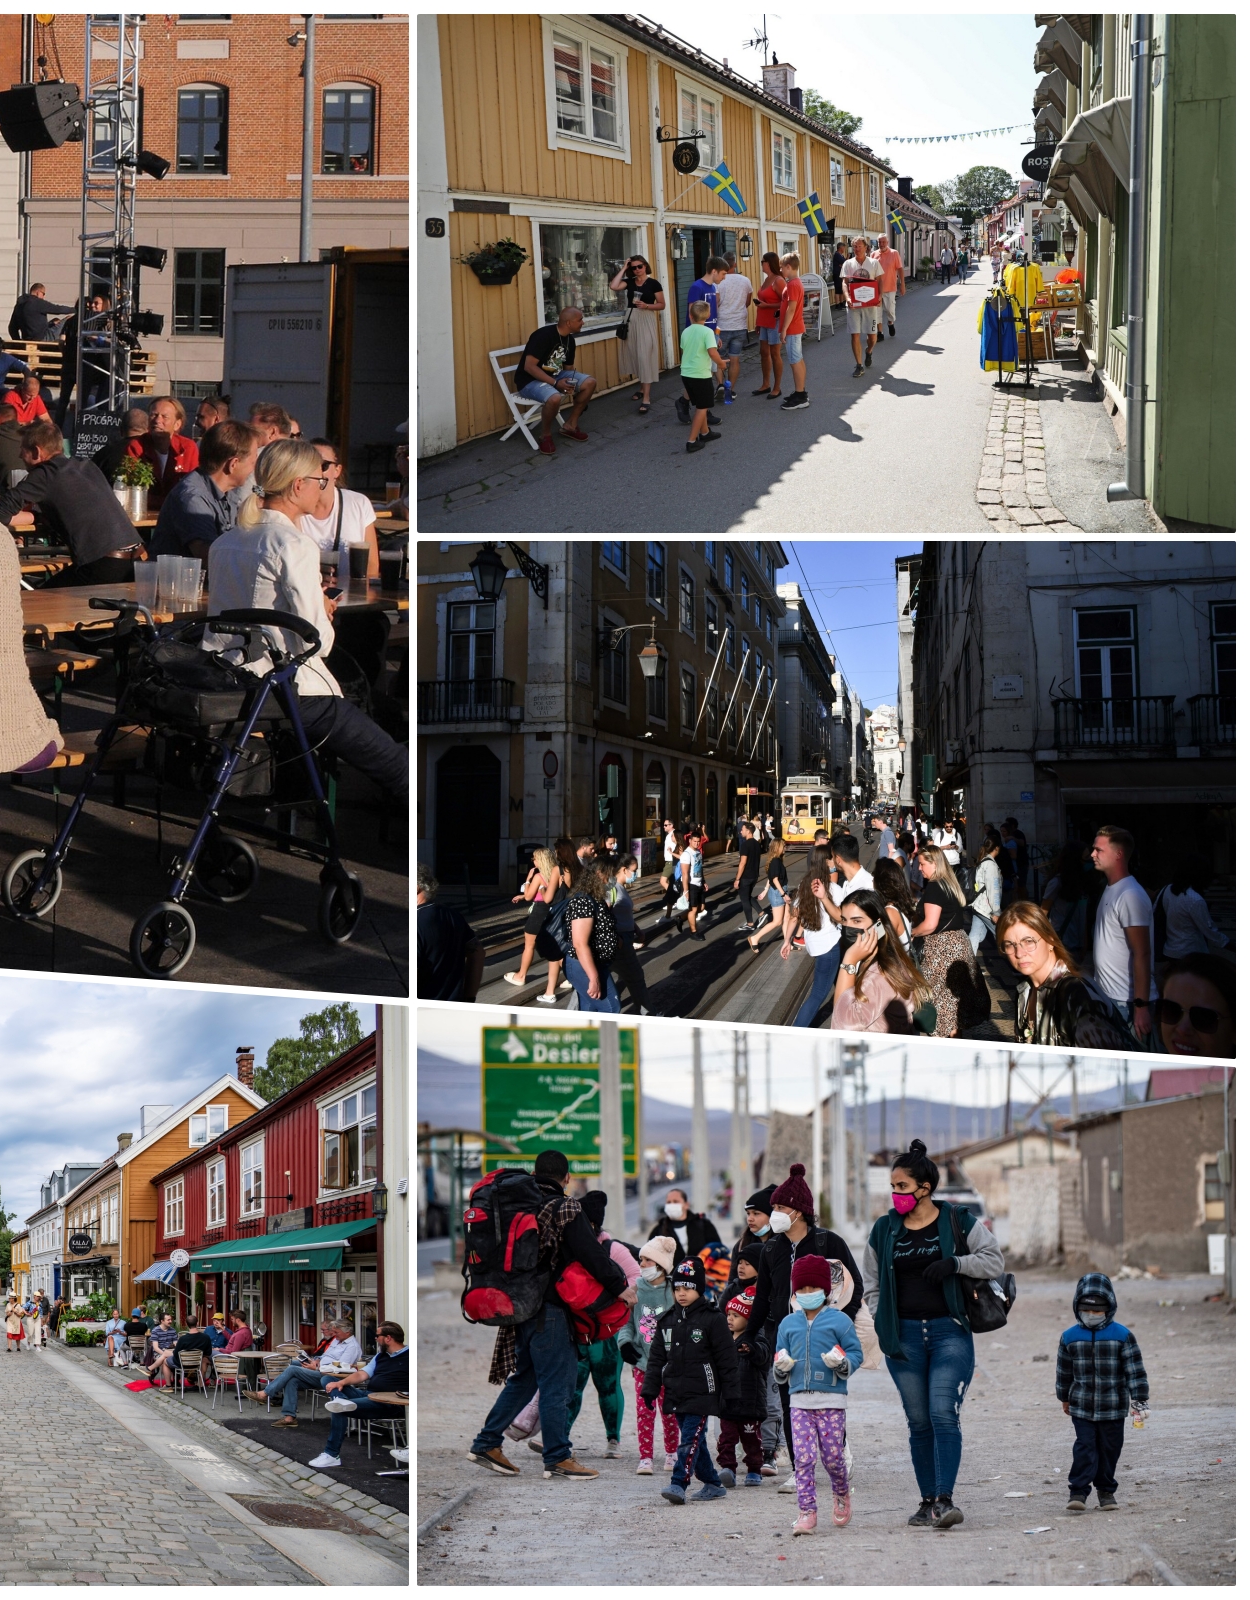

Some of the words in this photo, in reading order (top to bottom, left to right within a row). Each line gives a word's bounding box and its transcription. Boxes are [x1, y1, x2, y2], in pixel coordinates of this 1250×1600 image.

[428, 220, 443, 234] 35
[287, 318, 313, 330] 556210
[317, 318, 323, 331] 6
[533, 1032, 556, 1042] Ruta
[562, 1032, 582, 1042] del
[533, 1045, 602, 1063] Desier
